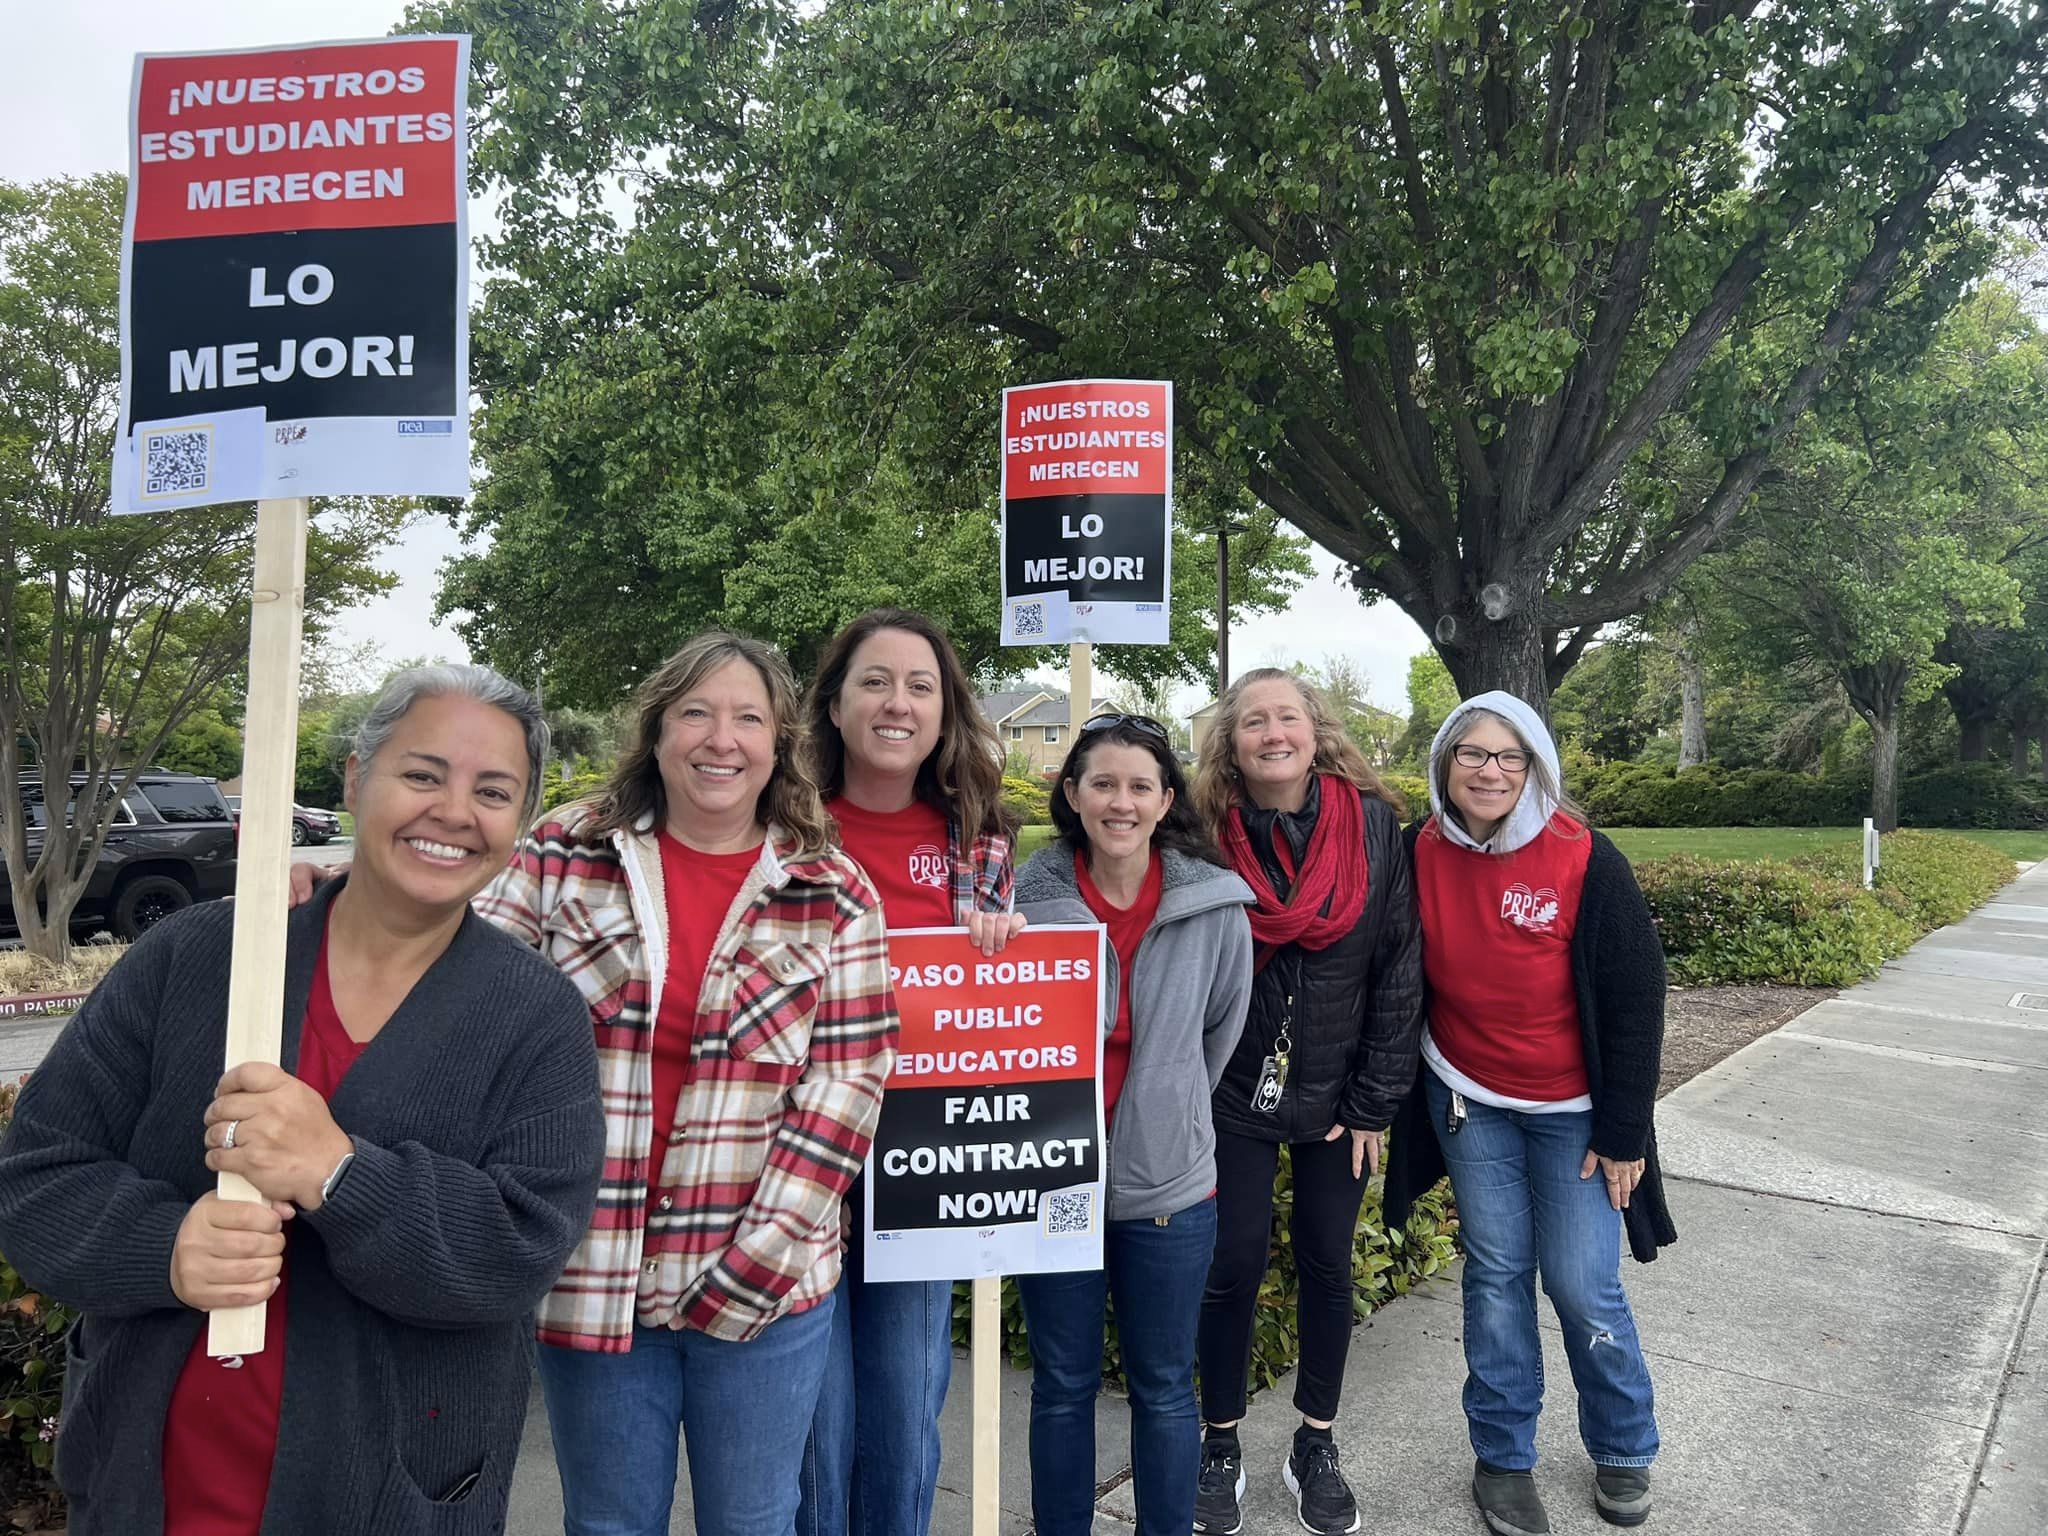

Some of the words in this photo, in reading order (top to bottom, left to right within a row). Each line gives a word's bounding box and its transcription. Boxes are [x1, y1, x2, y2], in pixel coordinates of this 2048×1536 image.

[168, 67, 425, 115] ¡NUESTROS
[141, 112, 453, 163] ESTUDIANTES
[187, 167, 404, 210] MERECEN
[249, 263, 335, 307] LO
[169, 335, 414, 394] MEJOR!
[399, 421, 424, 433] nea
[1020, 401, 1150, 428] ¡NUESTROS
[1007, 430, 1166, 455] ESTUDIANTES
[1029, 461, 1139, 481] MERECEN
[1061, 513, 1104, 539] LO
[1024, 556, 1145, 583] MEJOR!
[1501, 890, 1542, 921] PRPE
[975, 959, 1091, 986] ROBLES
[934, 1004, 1043, 1031] PUBLIC
[895, 1044, 1078, 1075] EDUCATORS
[945, 1093, 1031, 1124] FAIR
[883, 1138, 1090, 1177] CONTRACT
[938, 1189, 1037, 1220] NOW!
